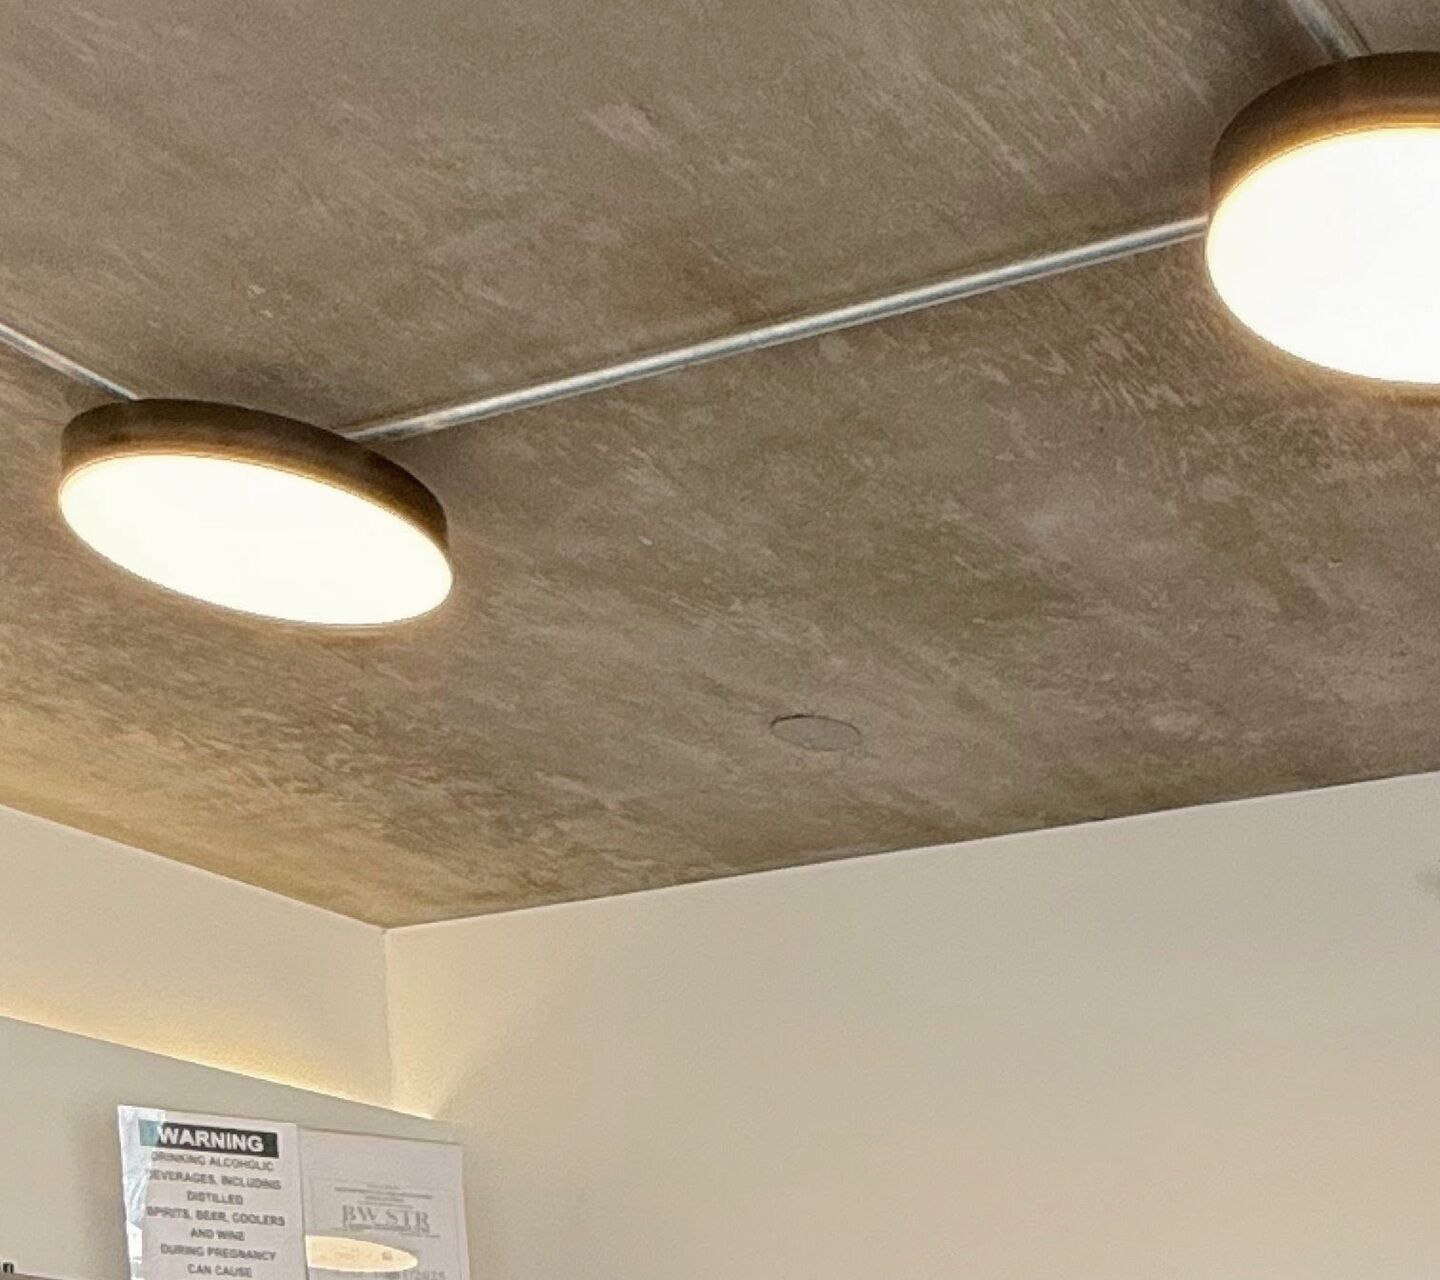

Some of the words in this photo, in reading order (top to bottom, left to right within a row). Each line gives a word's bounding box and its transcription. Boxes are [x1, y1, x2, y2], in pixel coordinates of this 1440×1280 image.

[157, 1125, 264, 1152] WARNING
[209, 1156, 274, 1171] ALCOHOLIC
[221, 1175, 282, 1190] INCLUDING
[186, 1190, 243, 1205] DISTILLED
[231, 1212, 285, 1226] COOLERS
[191, 1228, 214, 1239] AND
[215, 1230, 245, 1241] WINE
[160, 1243, 205, 1257] DURING
[207, 1247, 277, 1261] PREGNANCY
[187, 1263, 212, 1275] CAN
[215, 1264, 252, 1278] CAUSE
